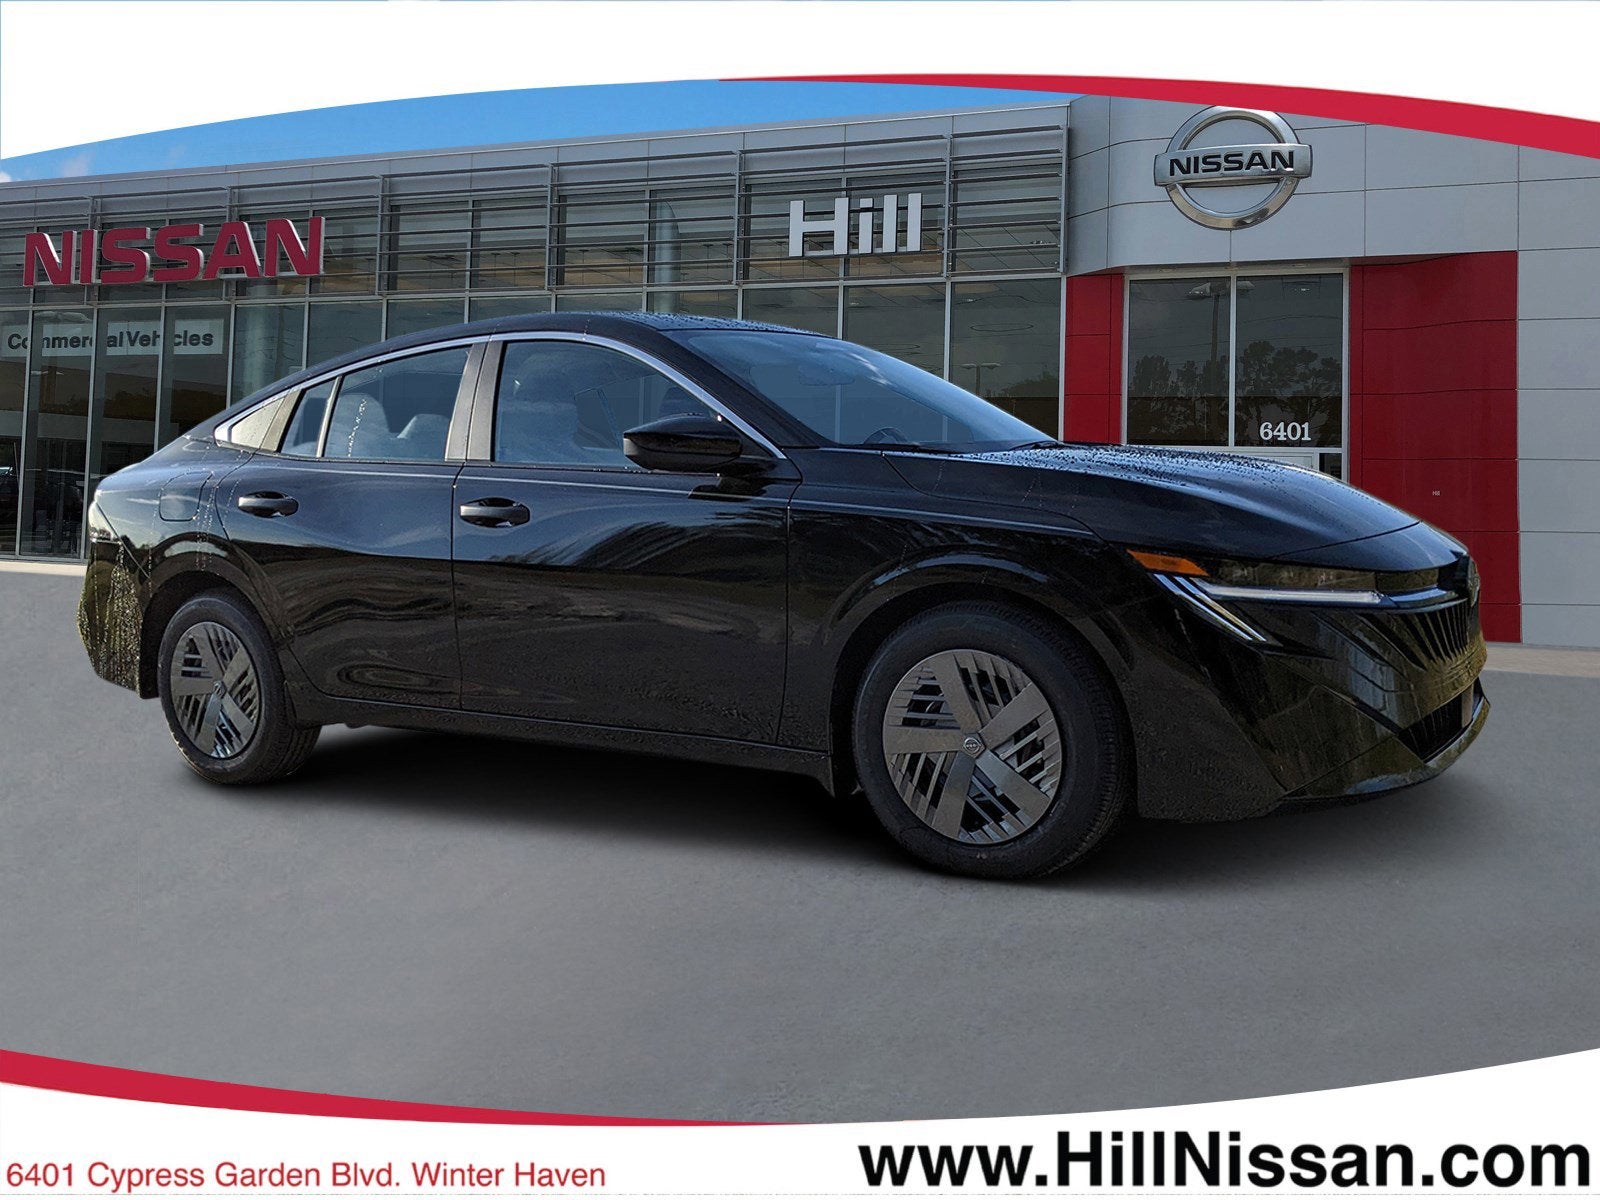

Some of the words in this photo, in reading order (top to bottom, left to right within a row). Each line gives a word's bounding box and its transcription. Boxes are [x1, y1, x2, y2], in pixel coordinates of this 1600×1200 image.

[1169, 150, 1294, 176] NISSAN
[788, 192, 923, 257] Hill
[23, 216, 326, 287] NISSAN
[7, 331, 125, 350] Commeral
[126, 330, 214, 347] Vehcles
[1259, 421, 1312, 441] 6401
